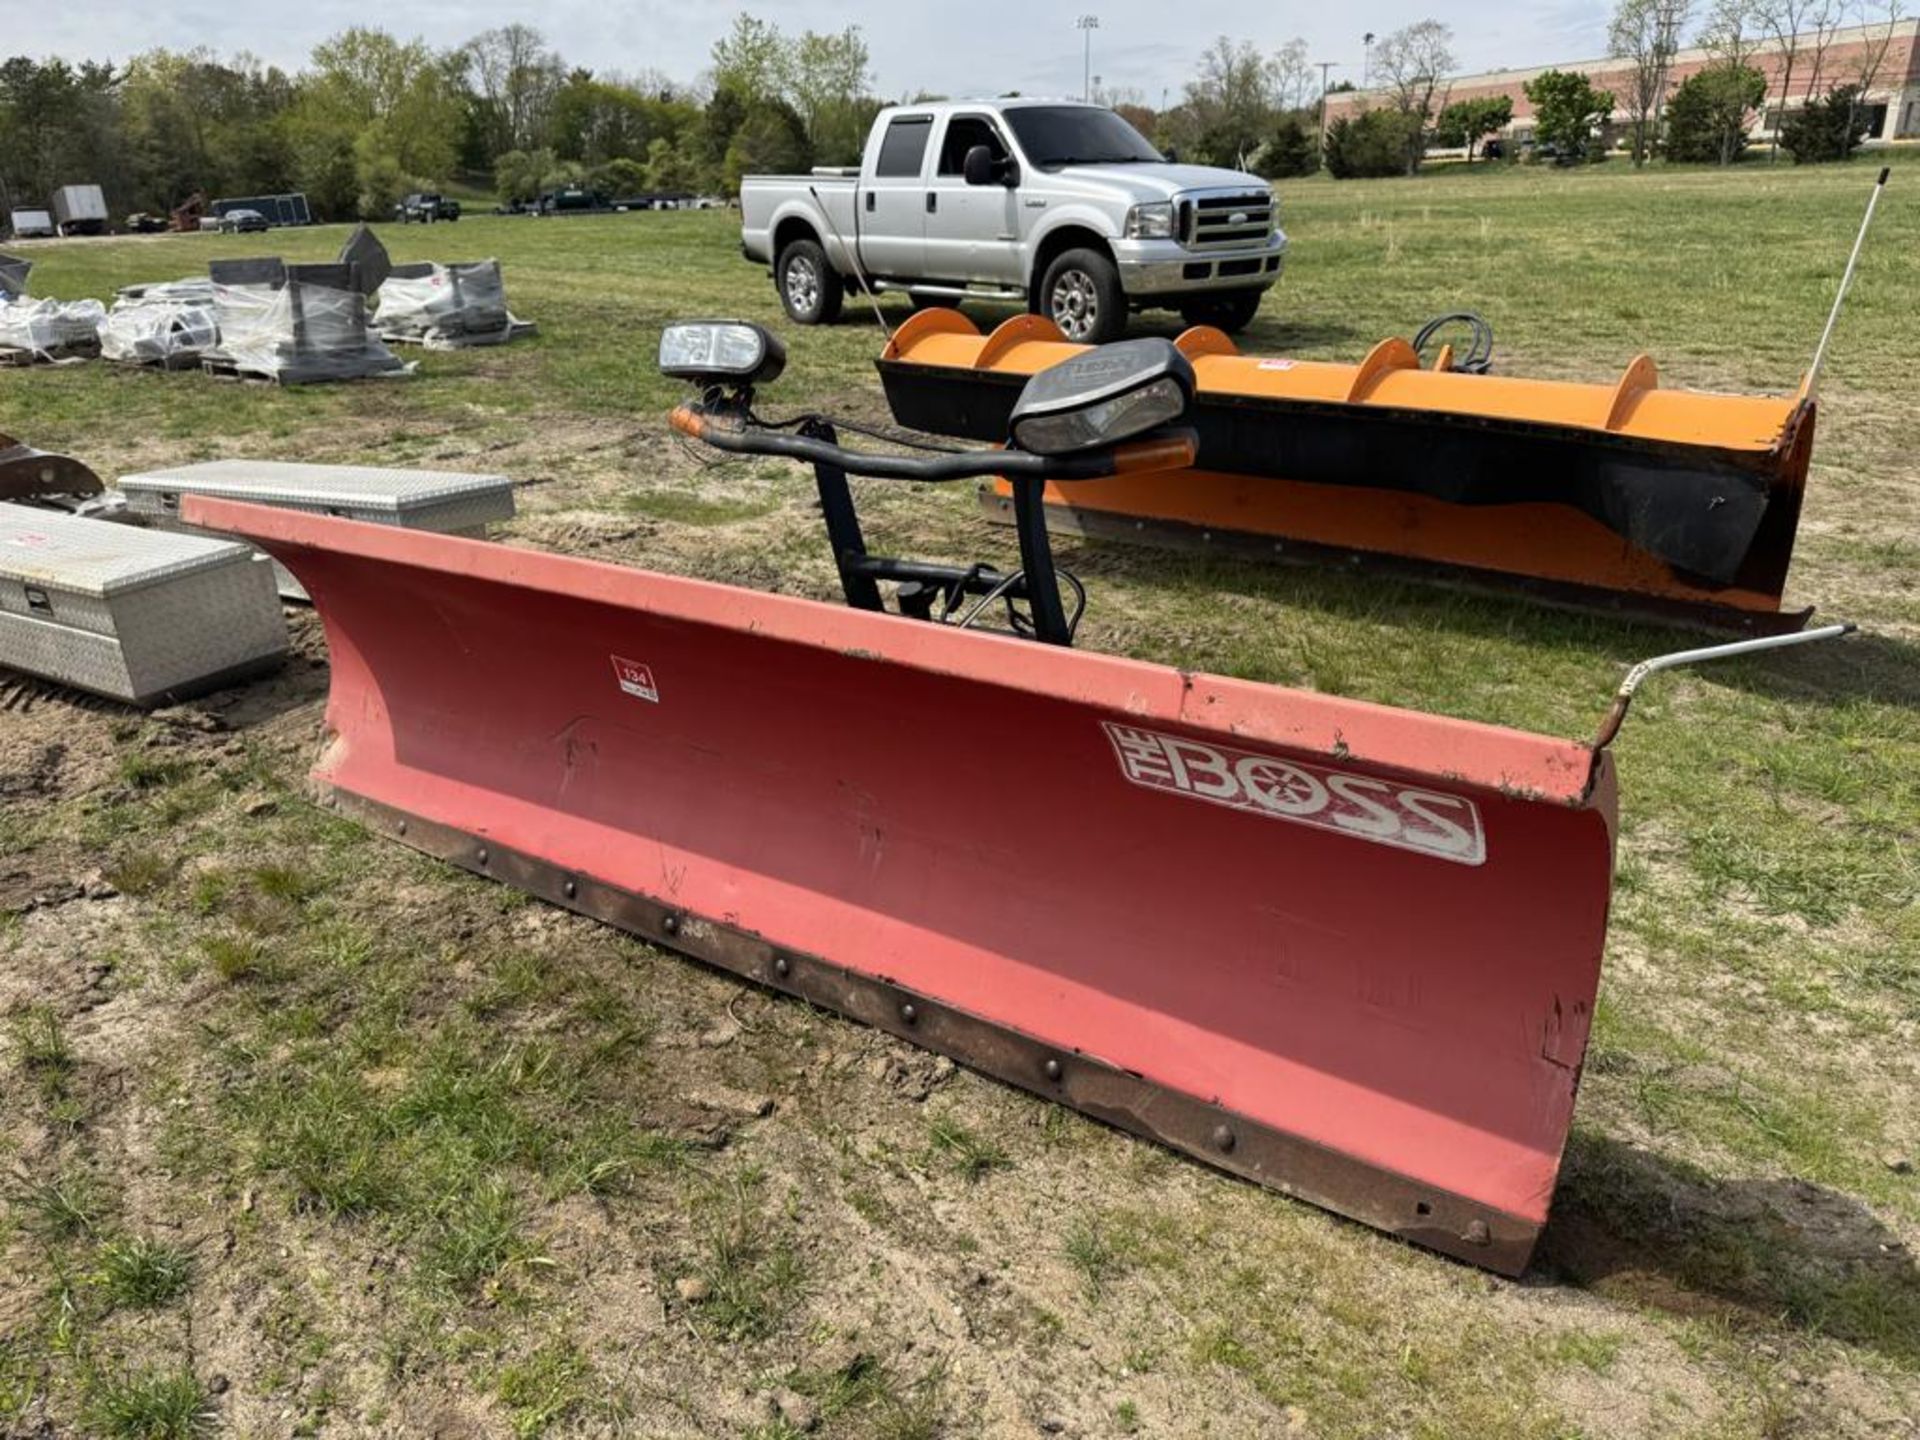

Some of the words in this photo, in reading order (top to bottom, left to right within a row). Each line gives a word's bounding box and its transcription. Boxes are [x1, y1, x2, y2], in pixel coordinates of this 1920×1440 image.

[623, 667, 648, 686] 134
[1110, 726, 1172, 779] THE
[1156, 736, 1472, 852] BOSS
